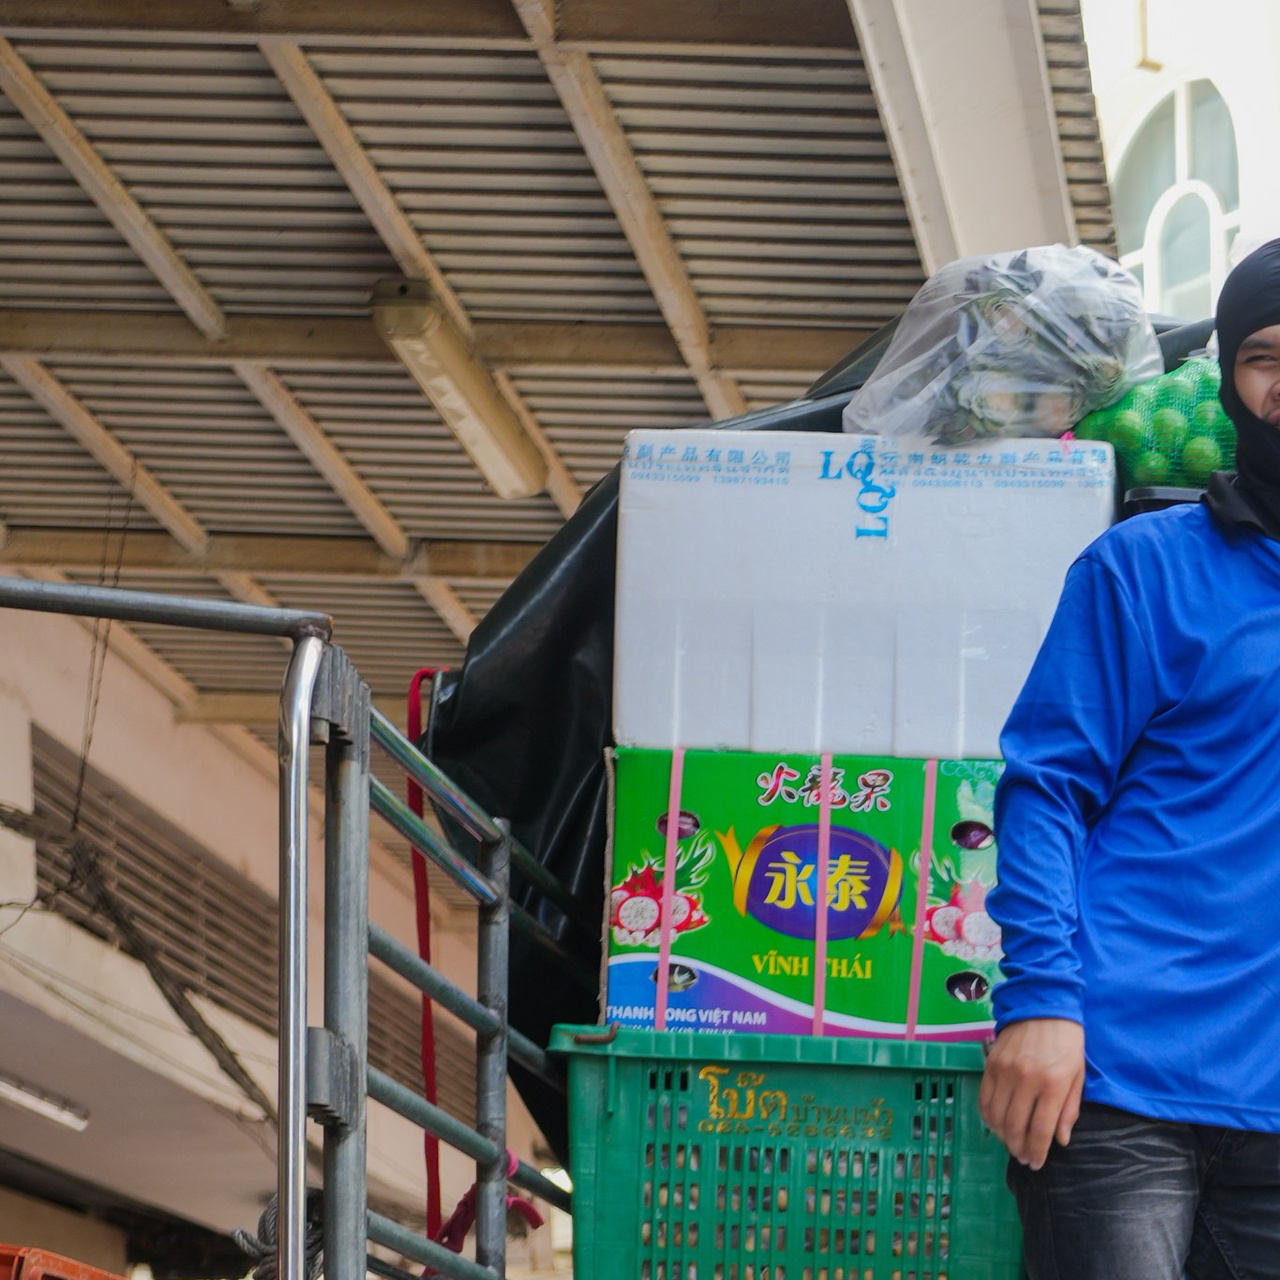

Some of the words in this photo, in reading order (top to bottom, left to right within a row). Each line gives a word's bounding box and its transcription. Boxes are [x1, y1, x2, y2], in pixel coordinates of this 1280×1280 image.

[763, 851, 872, 912] 永泰
[751, 948, 809, 976] VĨNH
[663, 1007, 698, 1023] ONG
[698, 1007, 731, 1027] VIỆT
[732, 1010, 768, 1026] NAM
